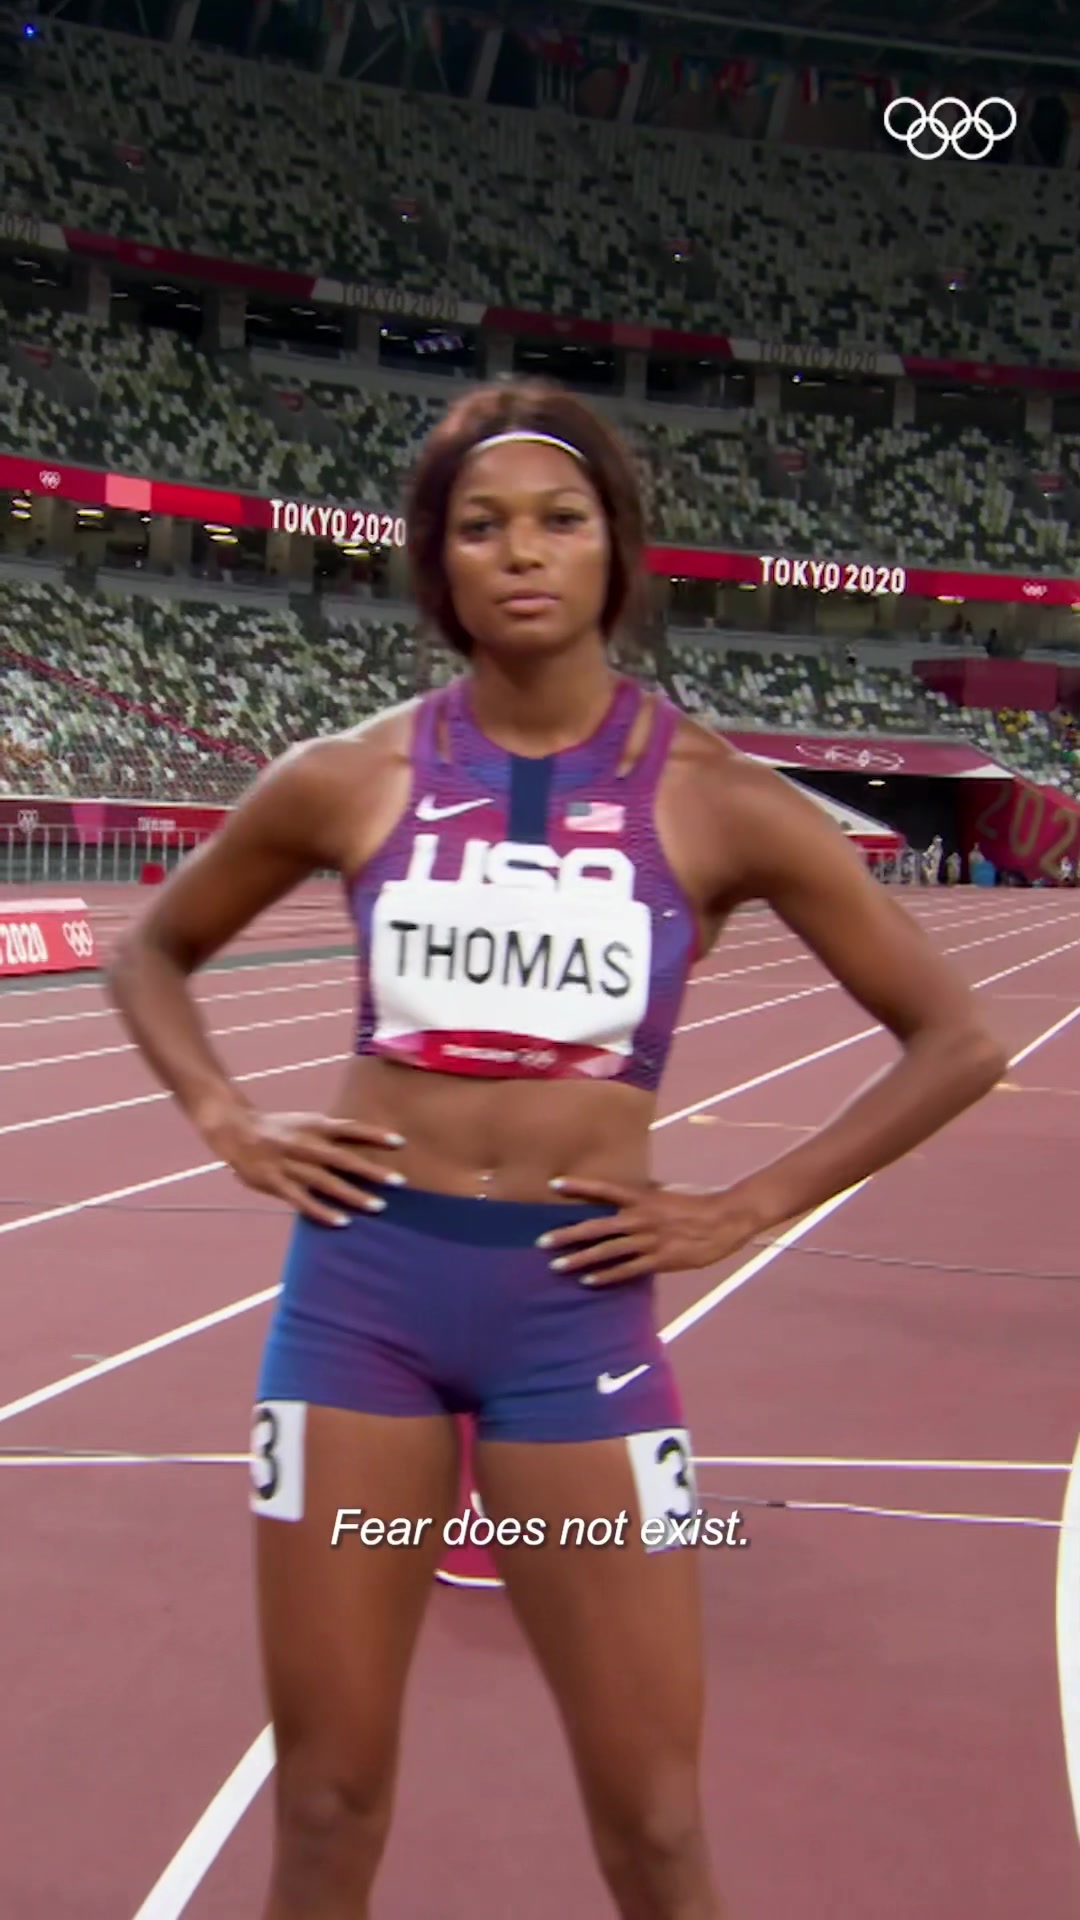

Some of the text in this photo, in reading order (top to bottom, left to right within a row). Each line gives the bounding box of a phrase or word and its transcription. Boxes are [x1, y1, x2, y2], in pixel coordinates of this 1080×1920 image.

[270, 498, 407, 547] TOKYO 2020
[759, 555, 905, 595] TOKYO 2020
[388, 920, 635, 998] THOMAS
